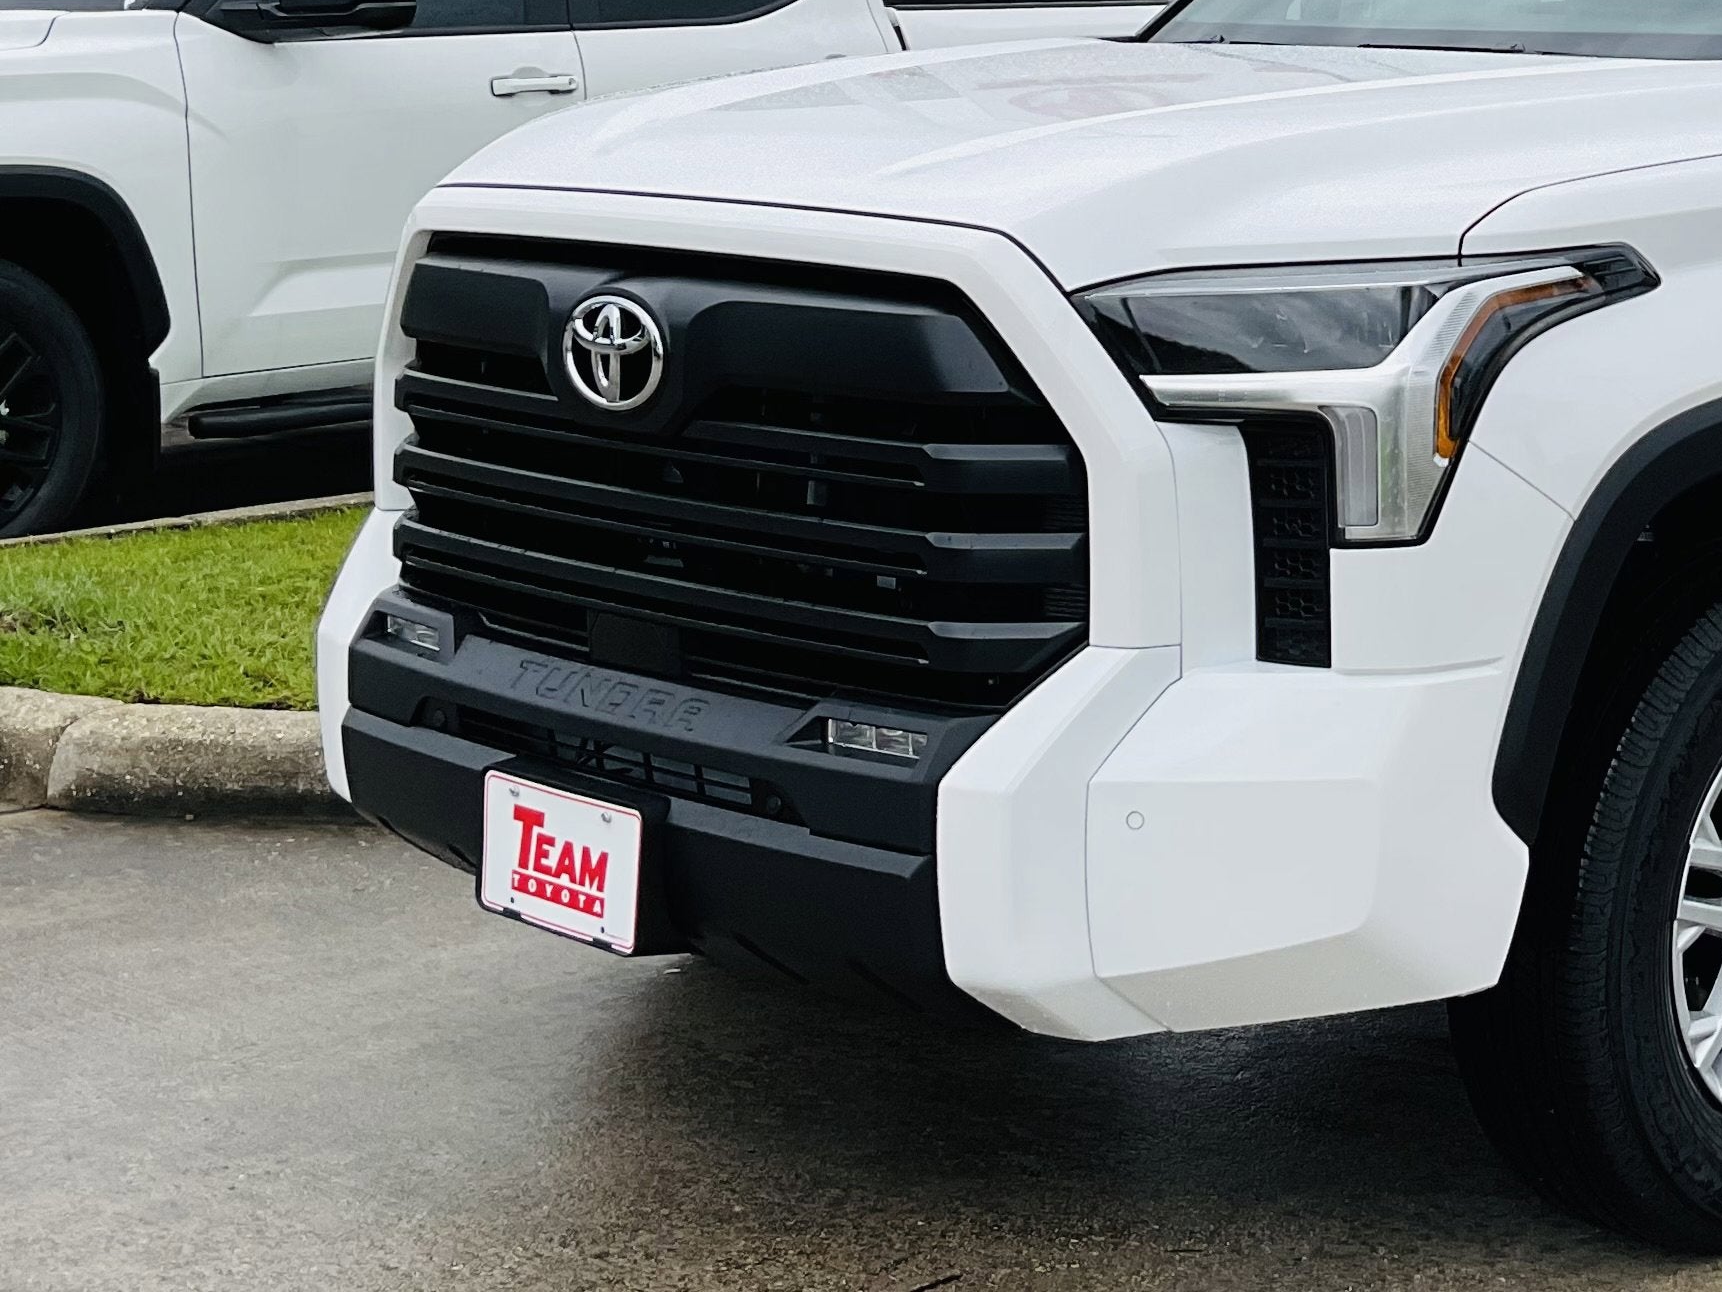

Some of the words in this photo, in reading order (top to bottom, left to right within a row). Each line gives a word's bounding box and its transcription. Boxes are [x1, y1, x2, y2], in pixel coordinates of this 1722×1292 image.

[510, 659, 711, 732] TUNDRA
[513, 803, 608, 893] TEAM
[512, 873, 604, 916] TOYOTA
